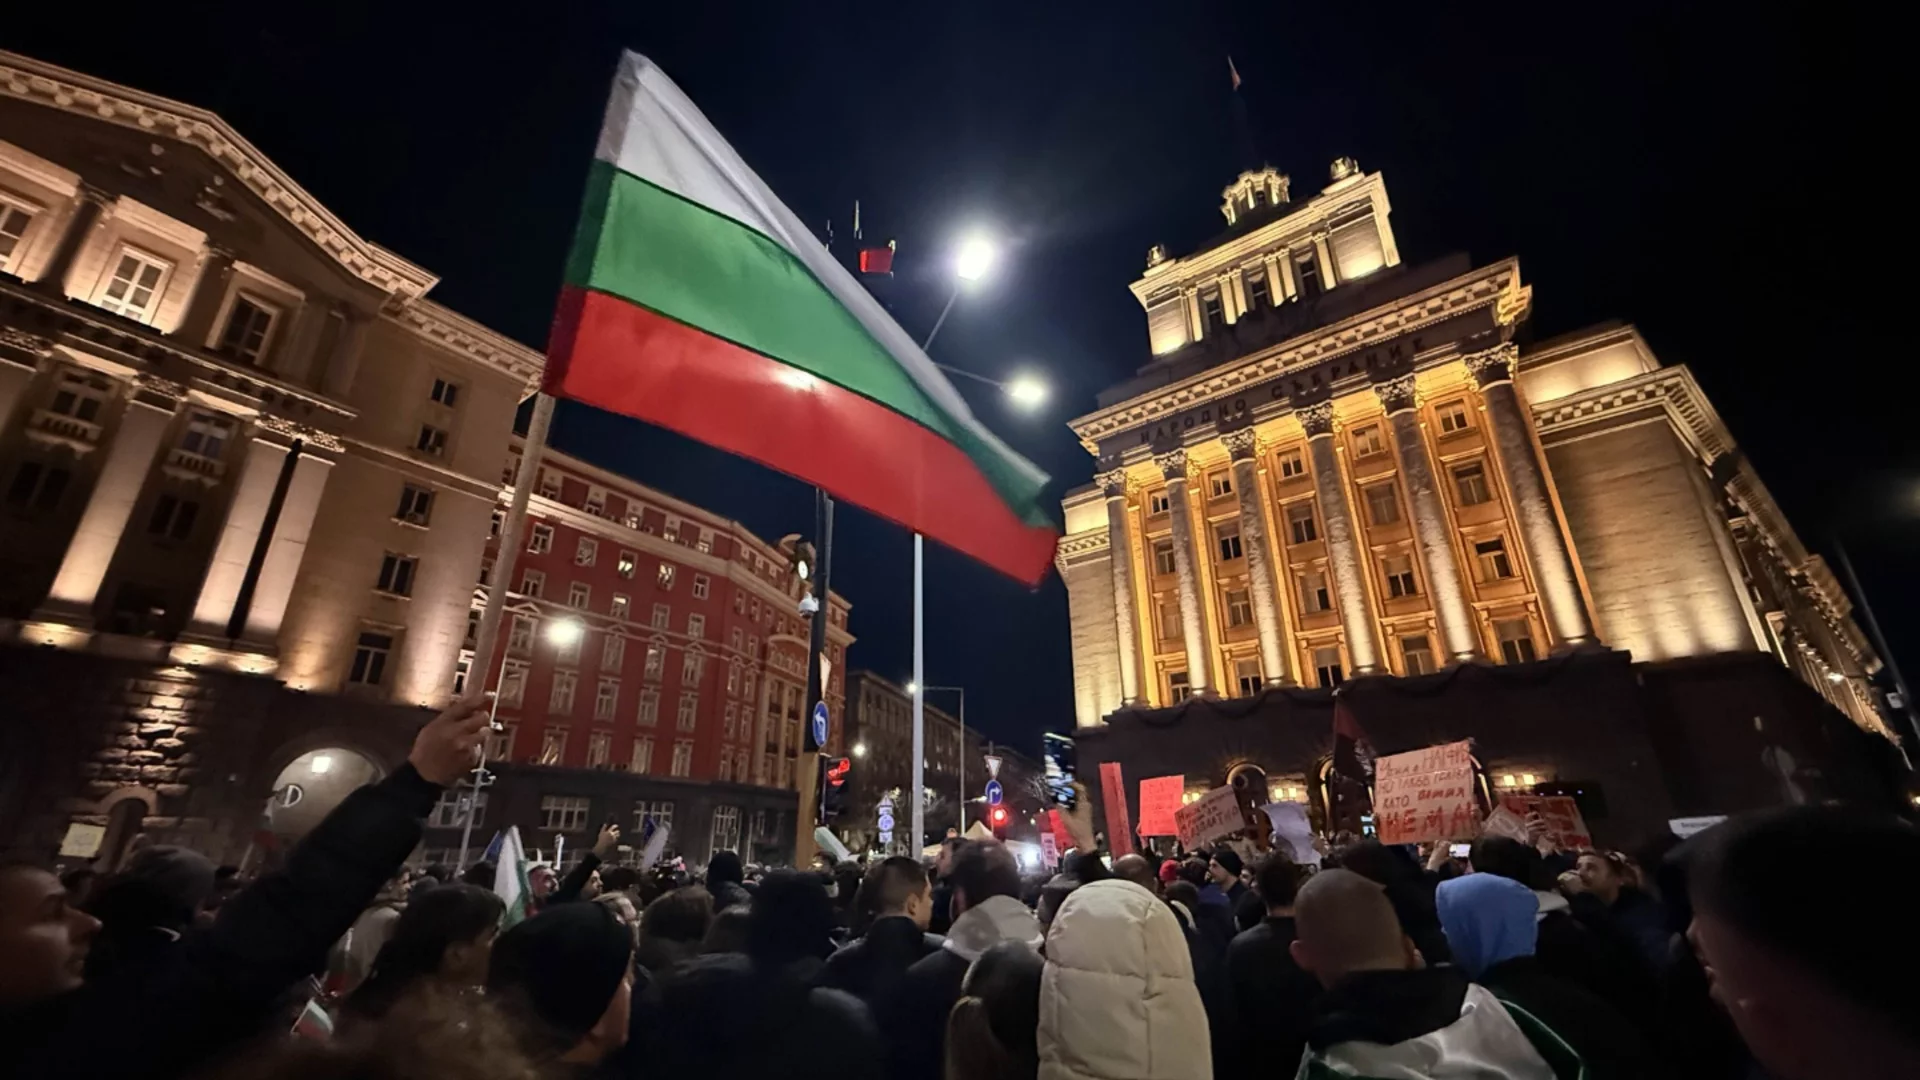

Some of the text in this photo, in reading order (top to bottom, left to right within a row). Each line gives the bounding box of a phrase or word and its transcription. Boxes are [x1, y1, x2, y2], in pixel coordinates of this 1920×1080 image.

[1140, 337, 1426, 444] НАРОДНО СЪБРАНИЕ
[1383, 795, 1410, 809] КАТО
